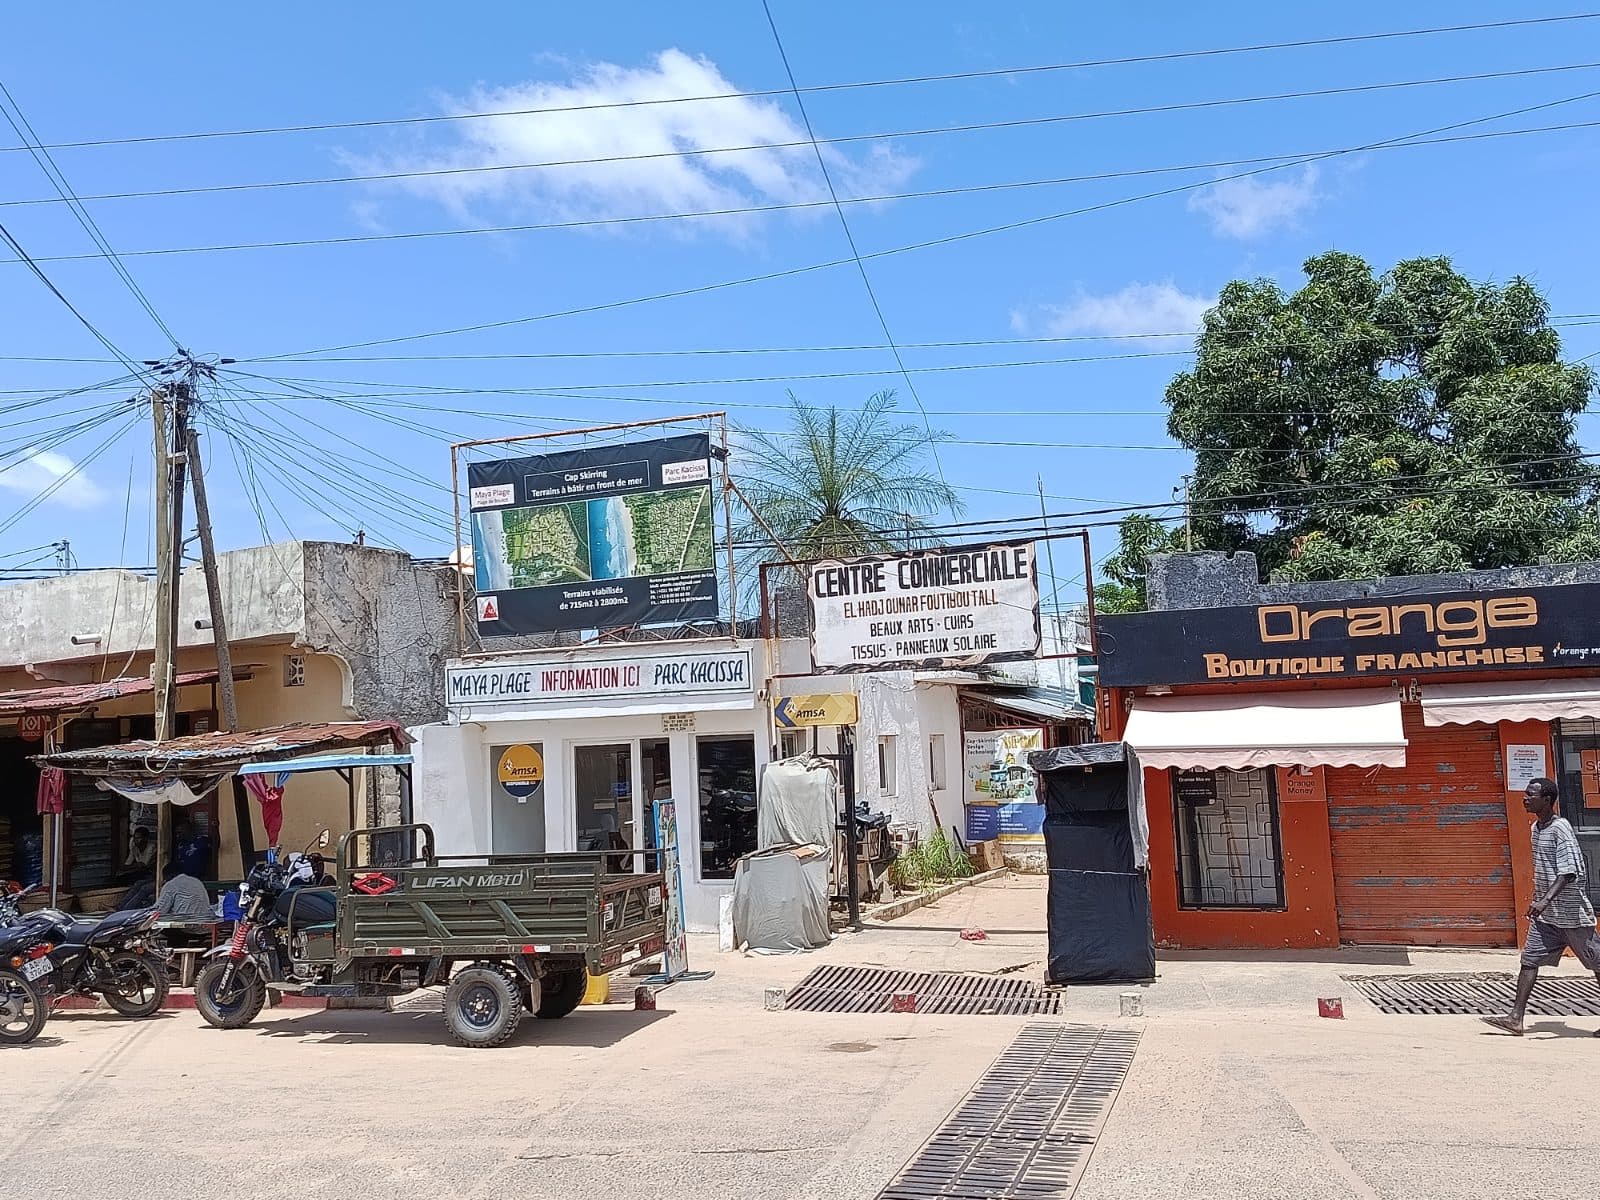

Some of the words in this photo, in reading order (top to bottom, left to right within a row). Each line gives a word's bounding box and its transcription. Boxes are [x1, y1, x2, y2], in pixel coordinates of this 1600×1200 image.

[564, 473, 579, 482] Cap
[580, 469, 608, 480] Skirring
[664, 467, 680, 476] Parc
[681, 463, 706, 474] Kacissa
[474, 489, 492, 500] Maya
[492, 488, 511, 499] Plage
[531, 487, 561, 497] Terrains
[567, 484, 585, 493] bâtir
[586, 482, 596, 490] en
[596, 479, 616, 489] front
[616, 478, 627, 487] de
[627, 477, 643, 486] mer
[814, 562, 886, 598] CENTRE
[897, 548, 1028, 590] COMMERCIALE
[563, 589, 591, 599] Terrains
[591, 585, 624, 596] viabilisés
[559, 602, 569, 610] de
[569, 599, 594, 609] 715m2
[600, 597, 629, 606] 2800m2
[843, 602, 857, 619] EL
[858, 599, 885, 618] HADJ
[971, 588, 999, 607] TALL
[870, 620, 903, 638] BEAUX
[907, 617, 934, 634] ARTS
[943, 614, 974, 631] CUIRS
[1257, 596, 1538, 647] Orange
[850, 643, 886, 660] TISSUS
[896, 638, 949, 656] PANNEAUX
[953, 633, 998, 651] SOLAIRE
[1560, 647, 1589, 660] orange
[1356, 646, 1545, 671] FRANCHISE
[452, 674, 488, 697] MAYA
[490, 672, 532, 695] PLAGE
[541, 666, 619, 692] INFORMATION
[623, 665, 641, 687] ICI
[654, 662, 688, 686] PARC
[690, 659, 744, 684] KACISSA
[1287, 779, 1315, 788] Orange
[1287, 786, 1314, 795] Money
[411, 875, 475, 889] LIFAN
[476, 873, 524, 887] MOTO
